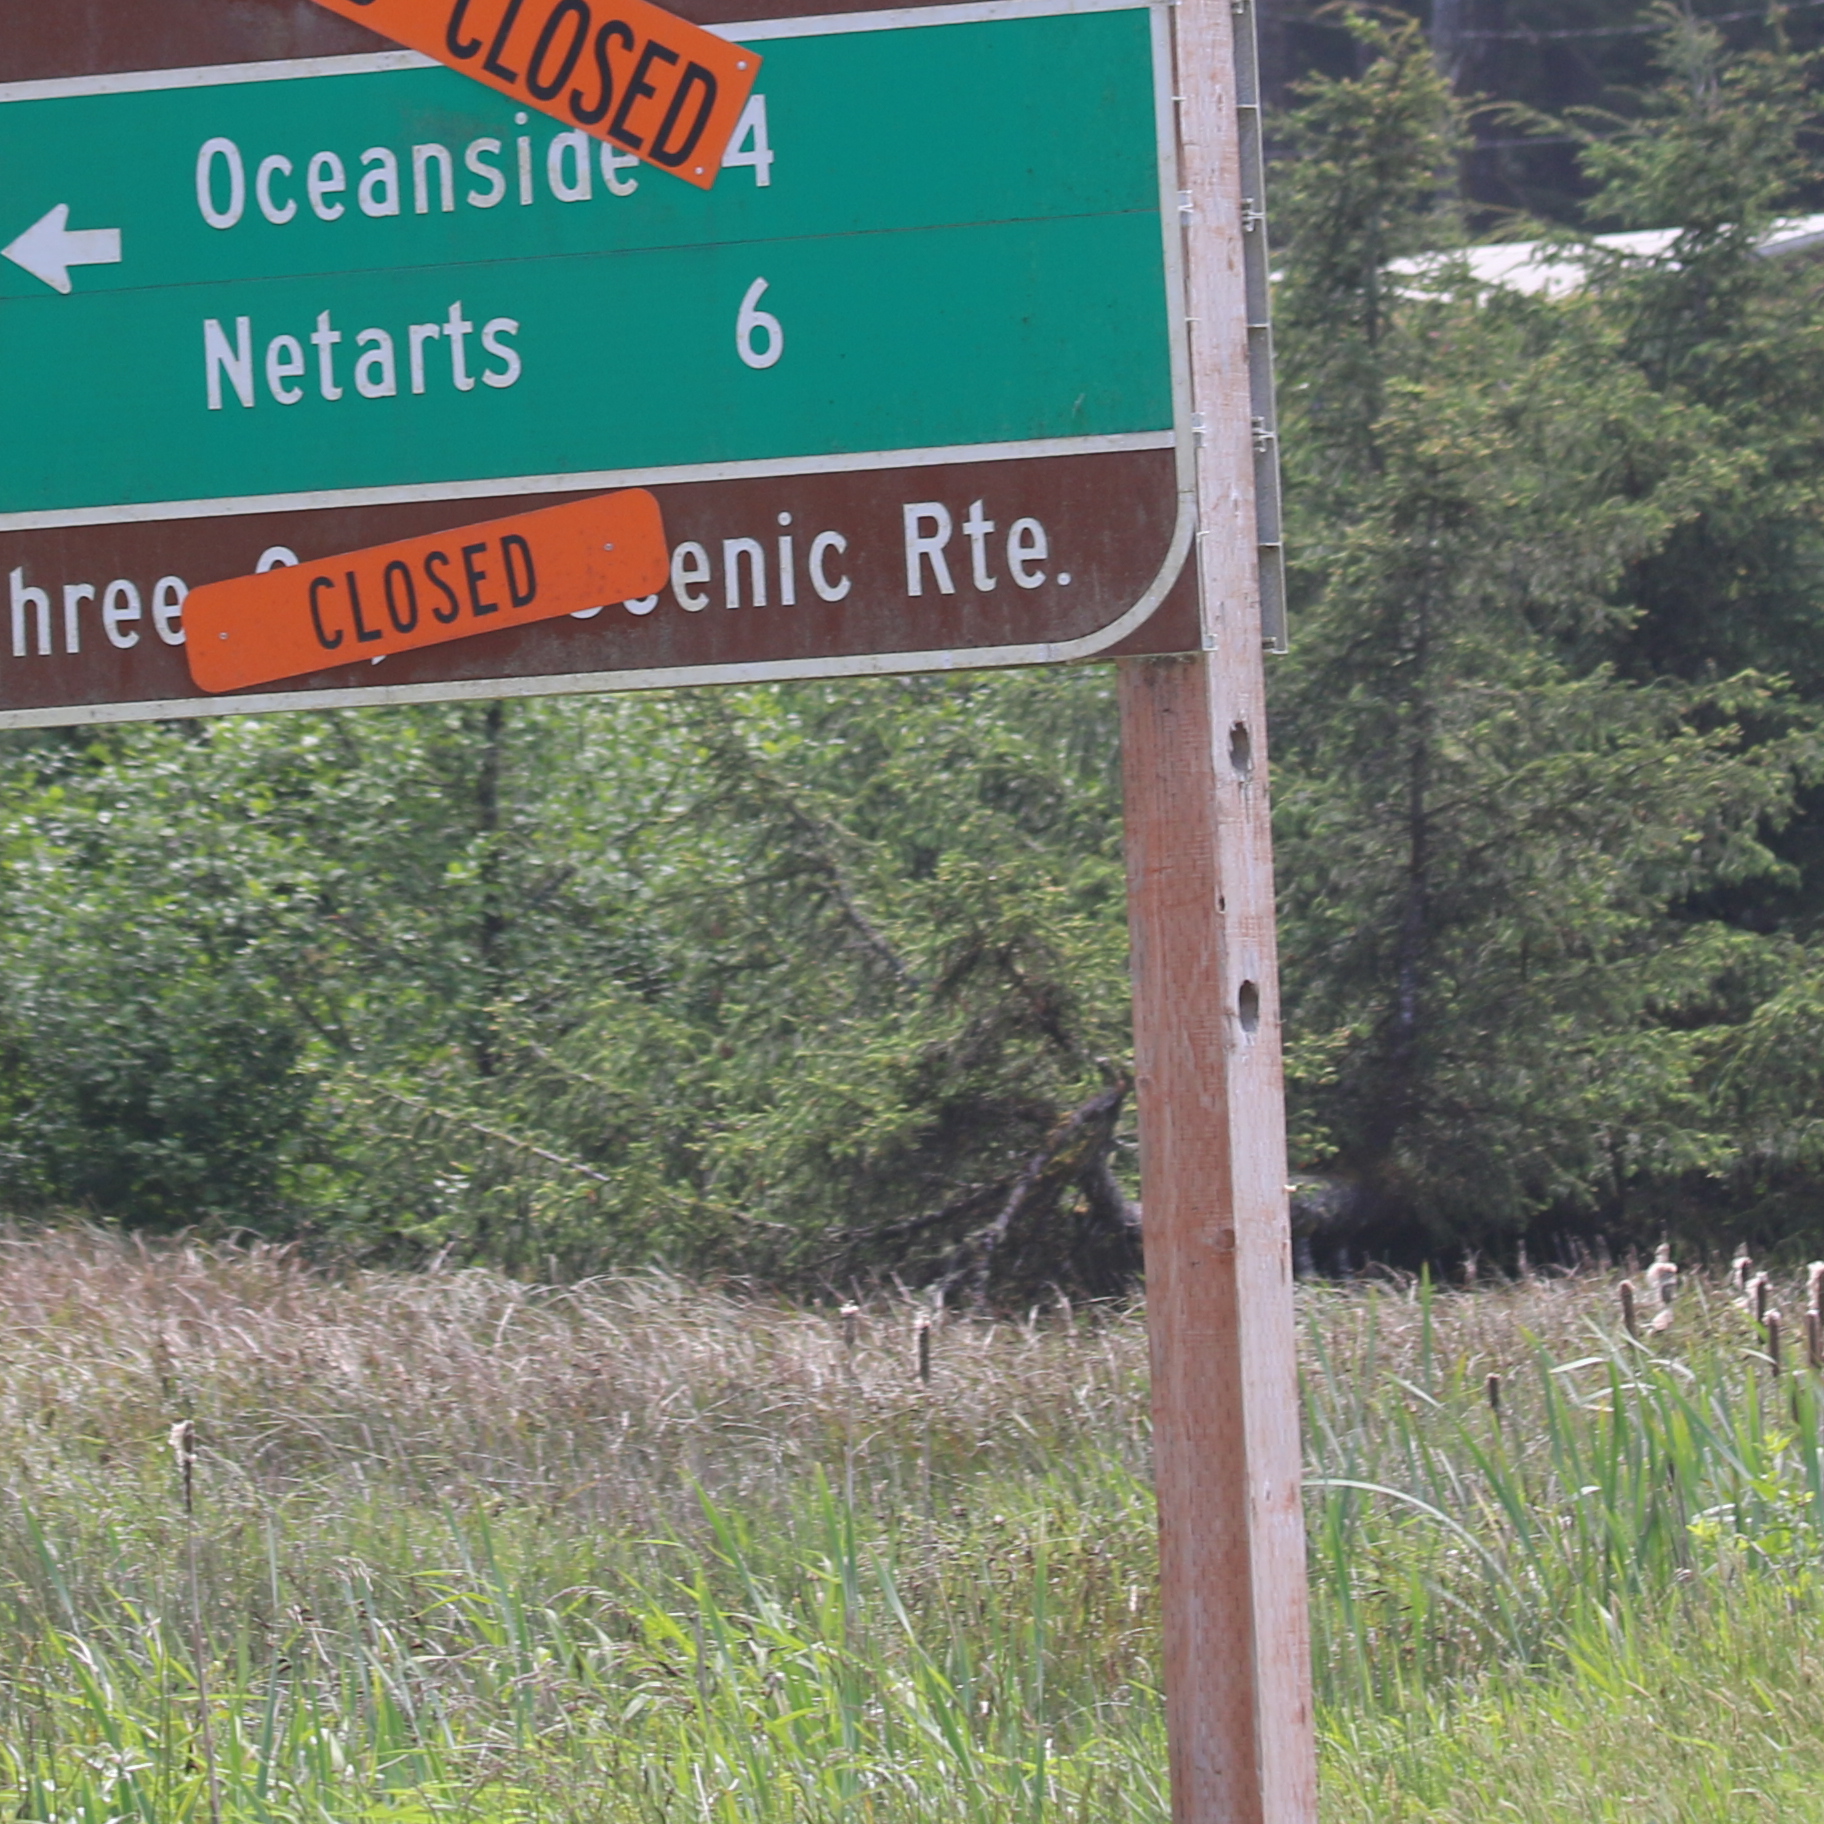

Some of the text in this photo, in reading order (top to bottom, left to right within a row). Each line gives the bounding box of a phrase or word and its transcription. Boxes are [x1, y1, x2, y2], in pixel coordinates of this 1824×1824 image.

[195, 93, 775, 229] Oceanside 4
[203, 276, 784, 410] Netarts 6
[308, 532, 538, 651] CLOSED
[568, 511, 851, 620] enic
[902, 498, 1071, 599] Rte.
